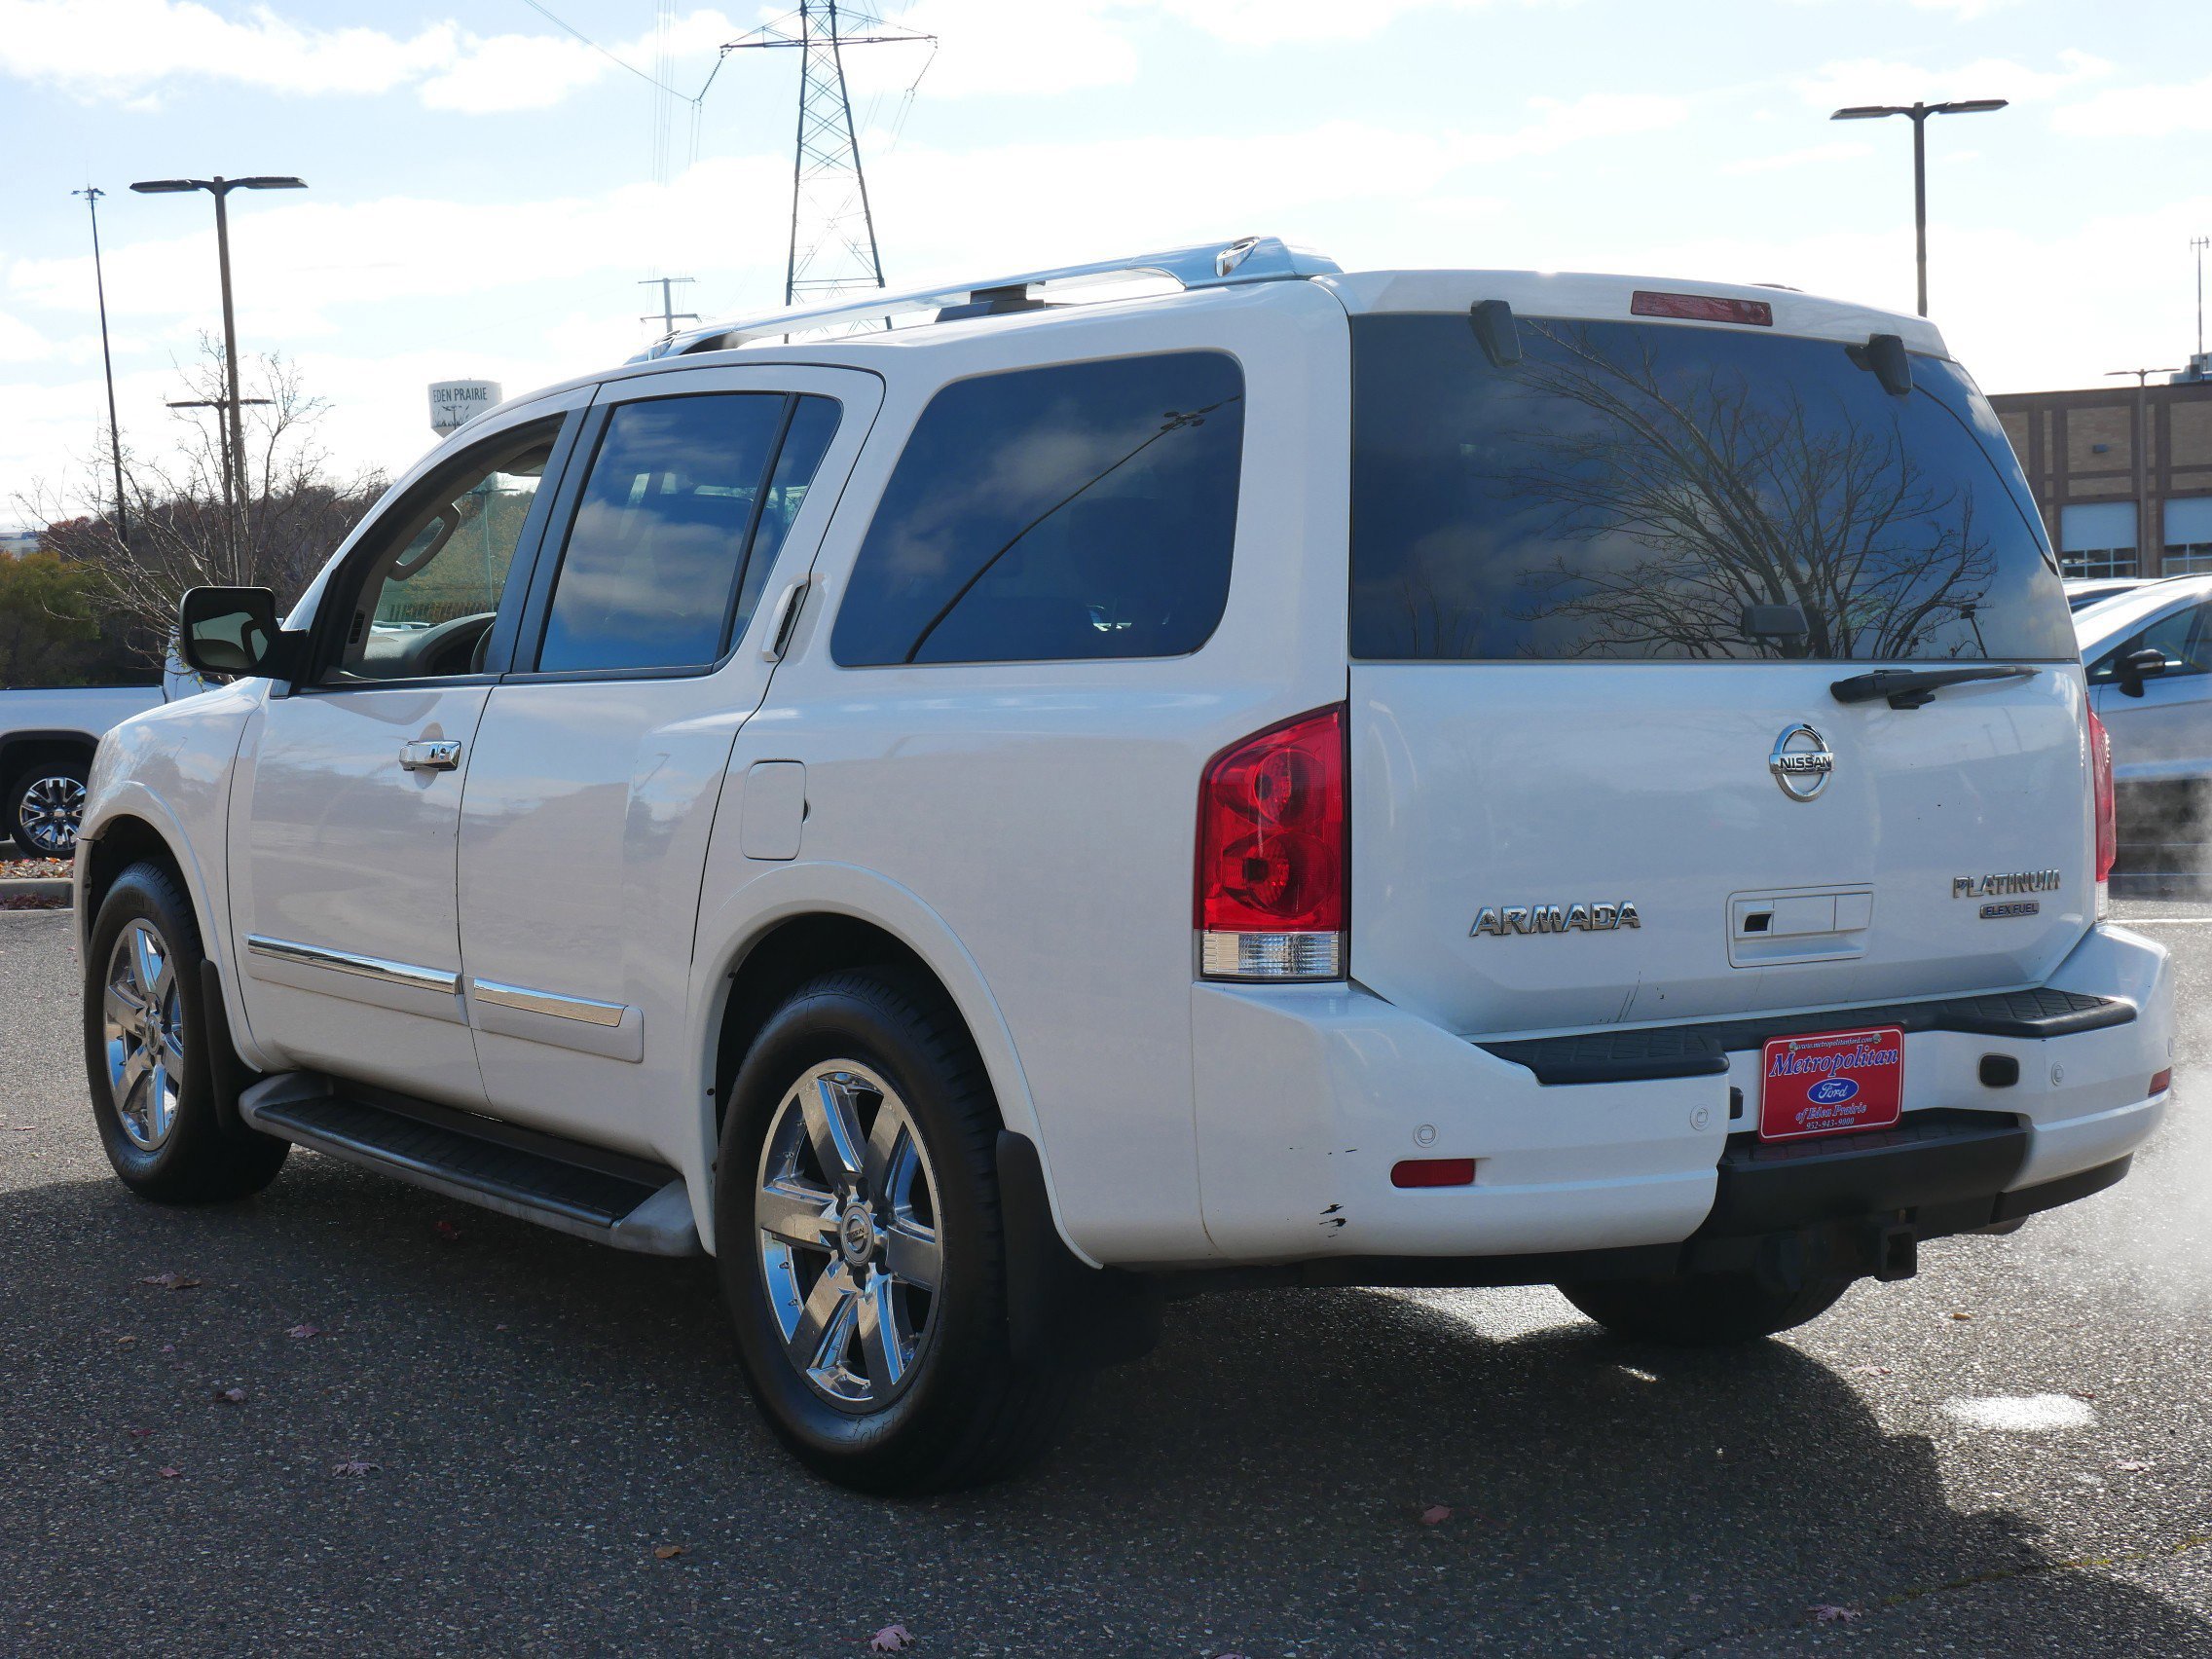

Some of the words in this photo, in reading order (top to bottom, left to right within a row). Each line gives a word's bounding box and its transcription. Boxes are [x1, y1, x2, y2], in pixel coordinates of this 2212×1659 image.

[432, 388, 452, 403] EDEN
[454, 387, 488, 401] PRAIRIE
[1779, 756, 1832, 769] NISSAN
[1952, 868, 2061, 899] PLATINUM
[1468, 900, 1641, 938] ARMADA
[1986, 905, 2011, 915] FLEX
[2013, 903, 2038, 913] FUEL
[1768, 1045, 1899, 1078] Metropolitan
[1818, 1082, 1849, 1100] Ford
[1795, 1108, 1809, 1124] of
[1807, 1106, 1832, 1120] Eden
[1832, 1101, 1867, 1117] Prairie
